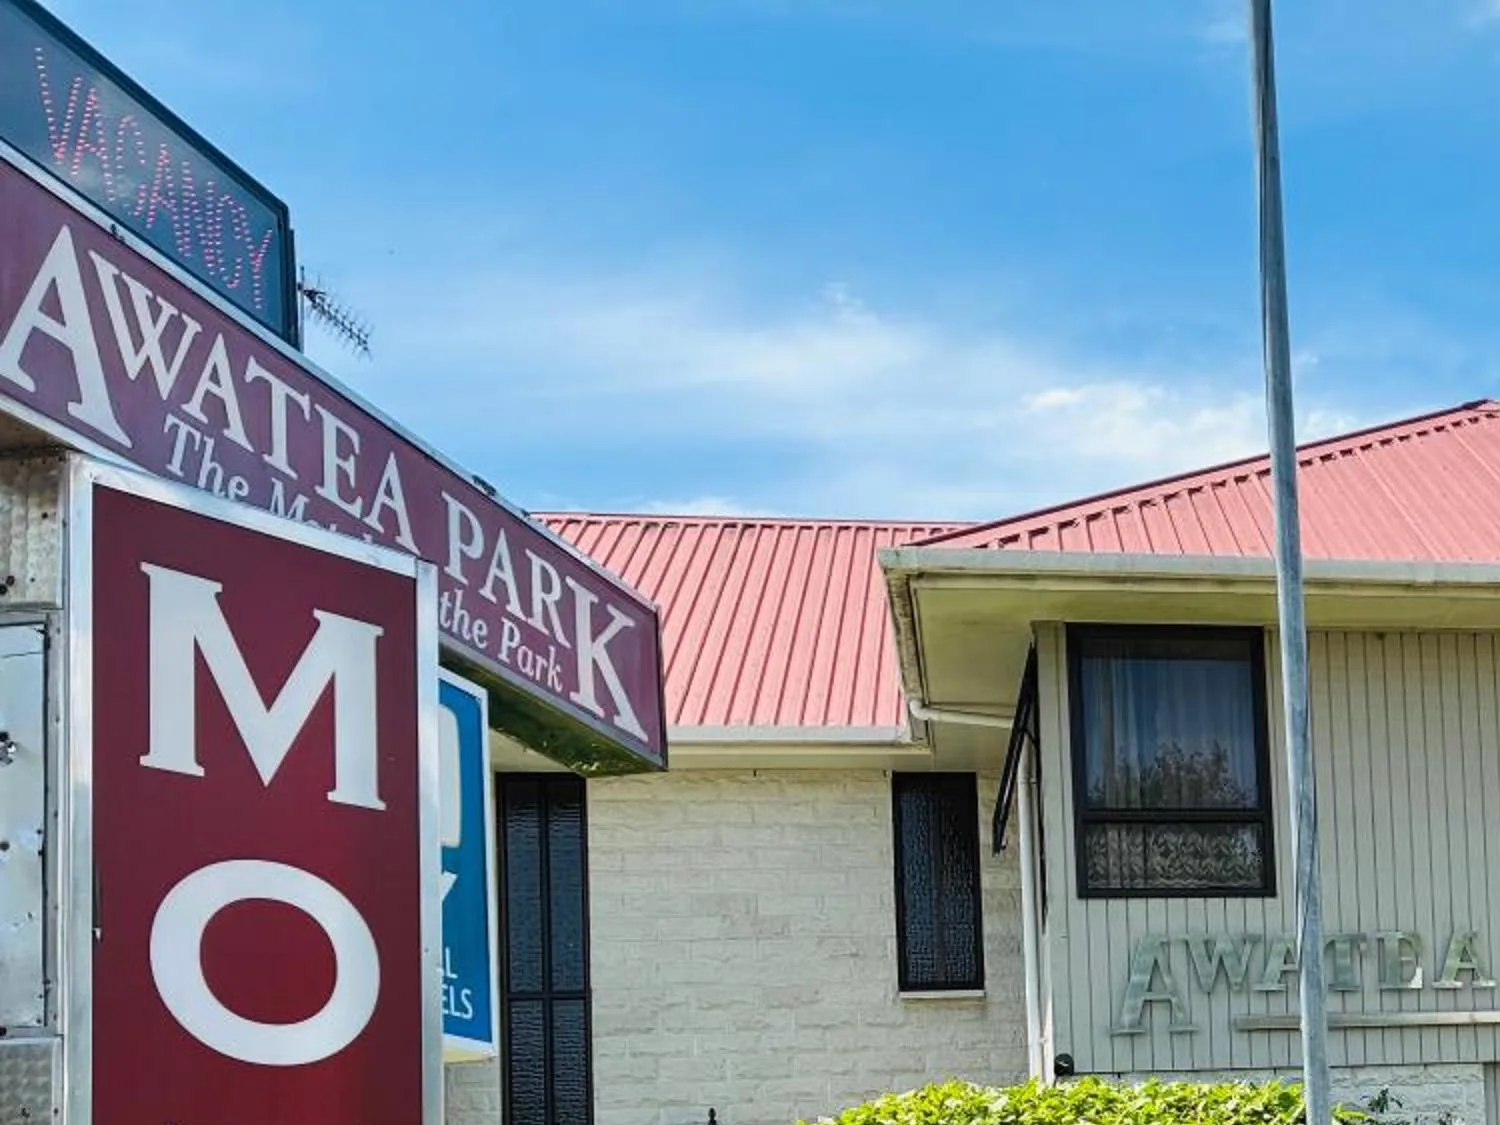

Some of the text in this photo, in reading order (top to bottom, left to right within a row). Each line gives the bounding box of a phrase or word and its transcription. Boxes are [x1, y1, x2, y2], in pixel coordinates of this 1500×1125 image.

[34, 47, 273, 309] VACANCY
[0, 225, 649, 742] AWATEA PARK
[163, 413, 563, 693] The the Park
[1109, 929, 1497, 1036] AWATEA
